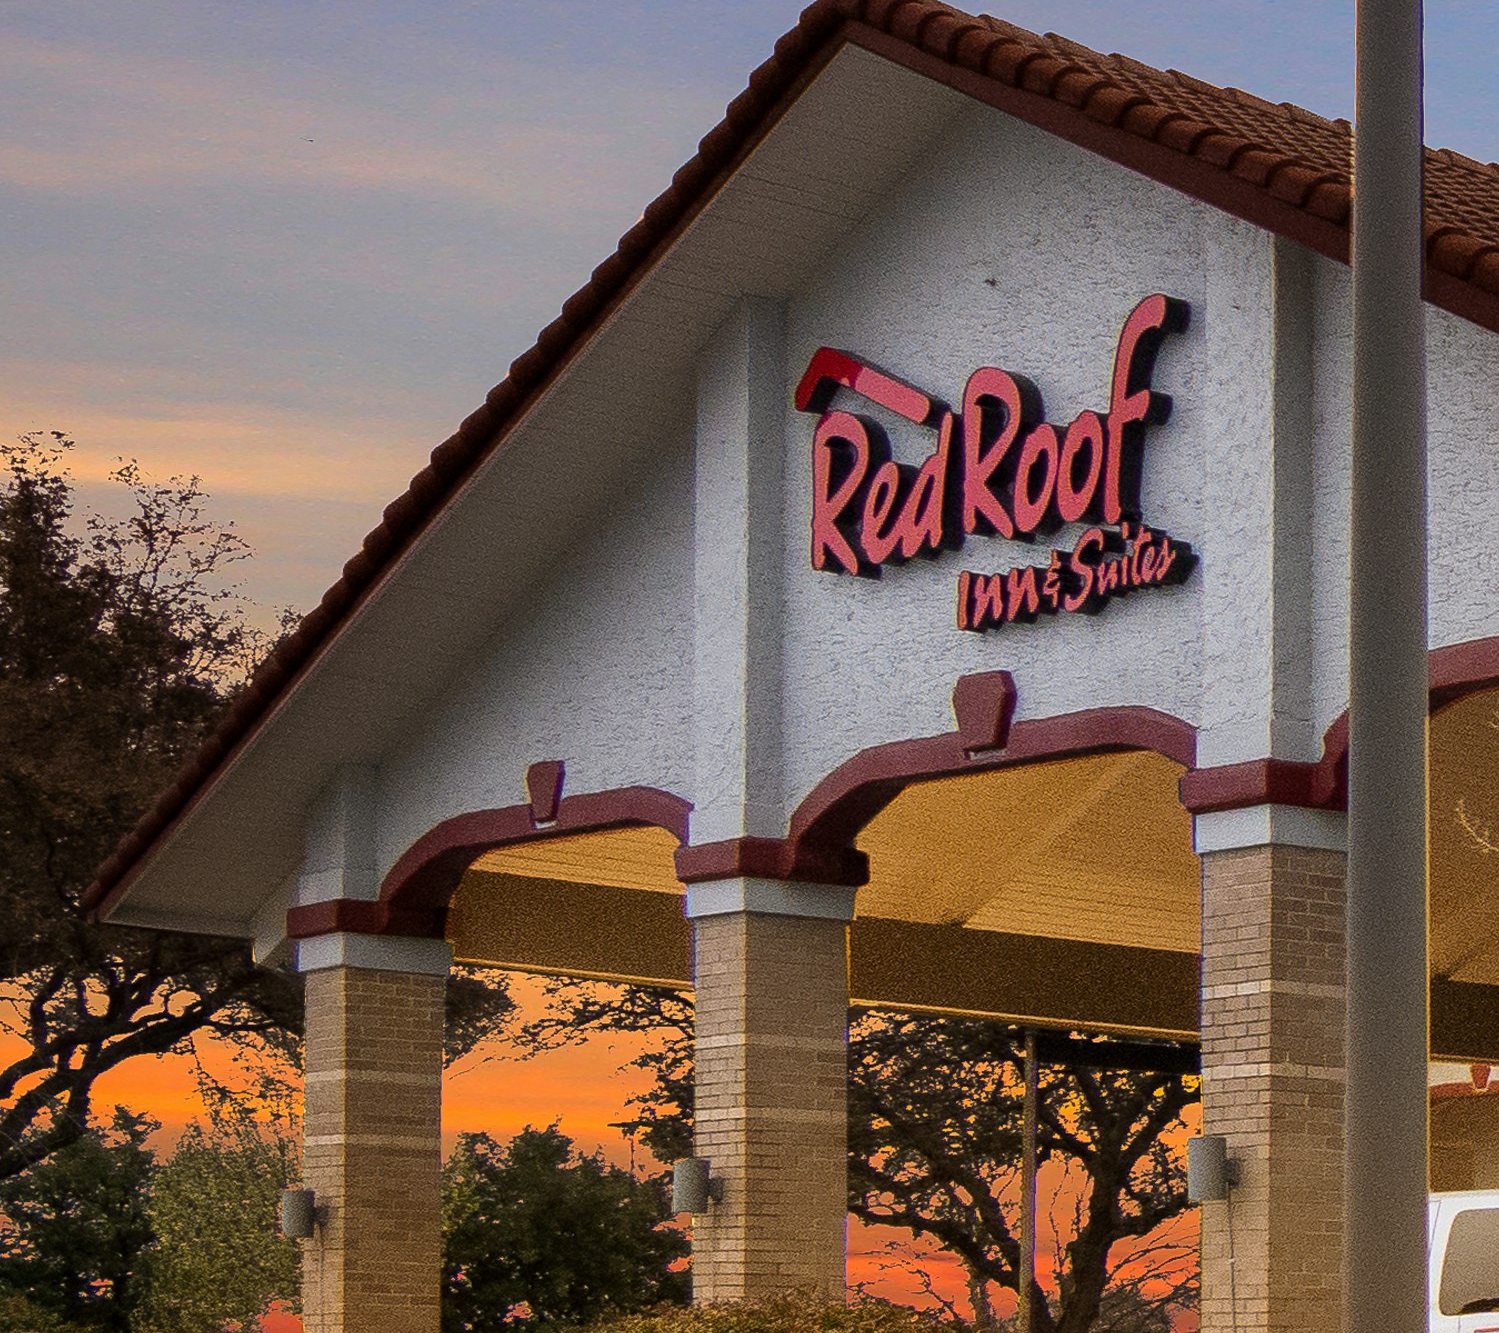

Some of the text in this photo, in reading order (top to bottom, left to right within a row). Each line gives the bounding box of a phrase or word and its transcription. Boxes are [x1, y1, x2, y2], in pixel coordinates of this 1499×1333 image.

[811, 293, 1168, 576] Red Roof
[956, 565, 1040, 631] Inn
[1064, 521, 1177, 613] Suites
